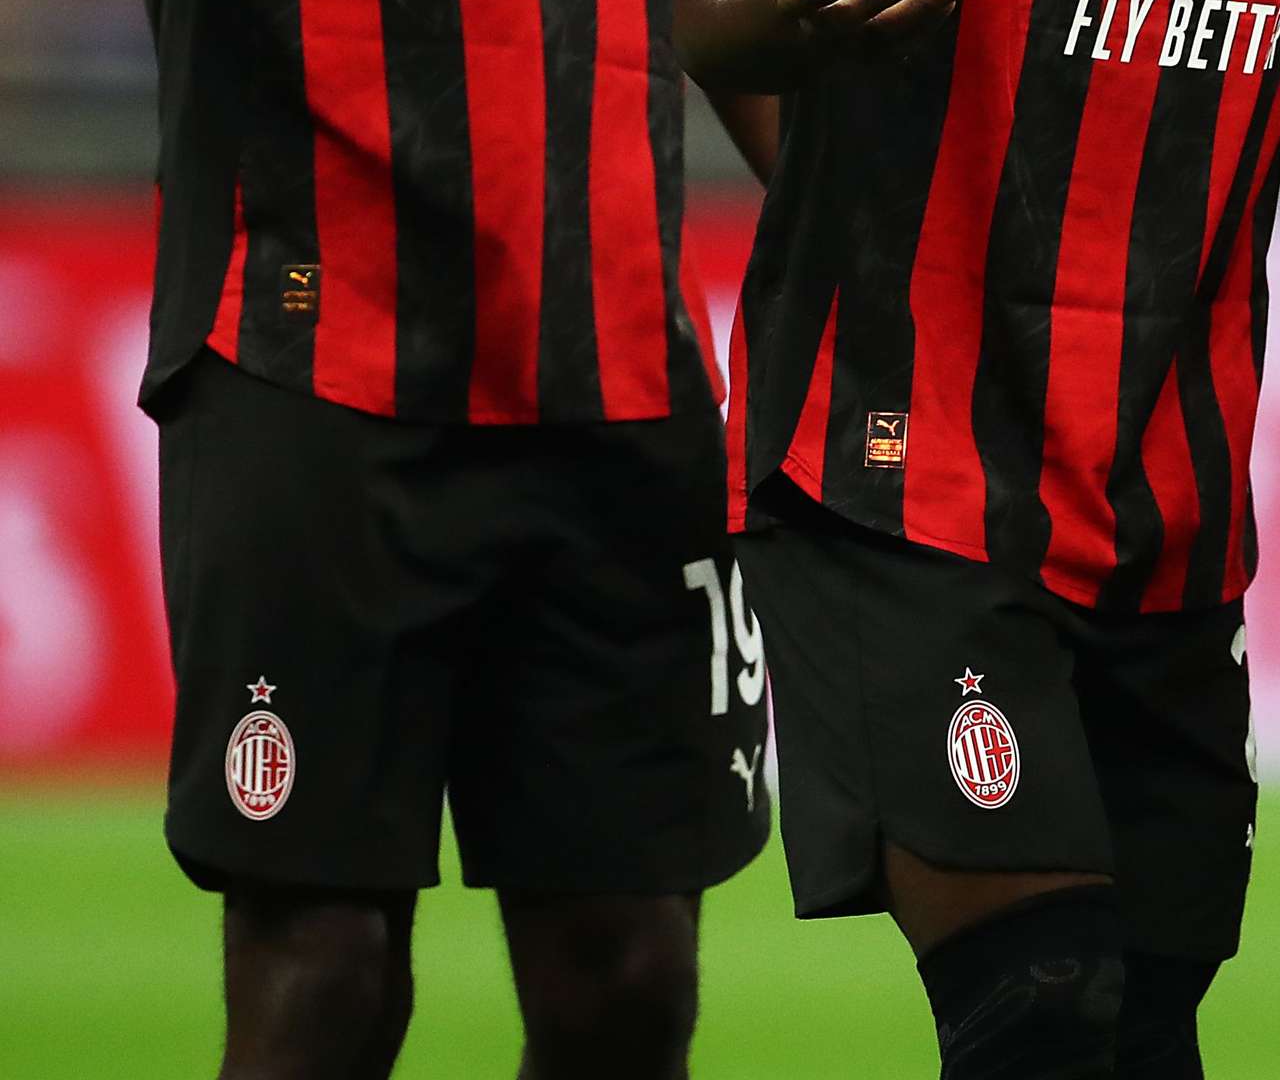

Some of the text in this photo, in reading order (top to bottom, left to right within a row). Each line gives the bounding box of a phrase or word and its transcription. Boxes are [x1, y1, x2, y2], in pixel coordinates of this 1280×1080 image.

[683, 557, 765, 716] 19
[960, 709, 997, 733] ACM
[975, 781, 1008, 797] 1899
